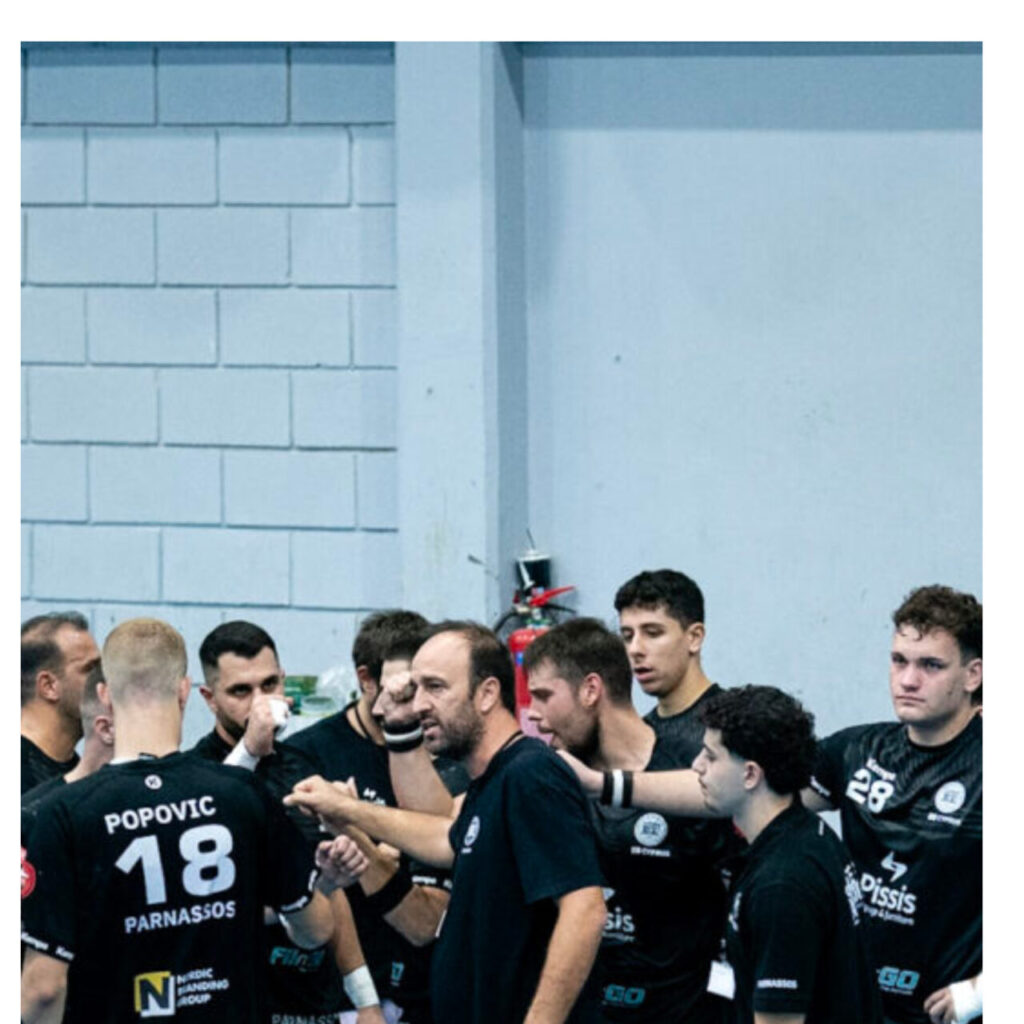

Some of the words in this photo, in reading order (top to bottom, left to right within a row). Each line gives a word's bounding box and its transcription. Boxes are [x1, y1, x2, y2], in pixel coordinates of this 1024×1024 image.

[845, 768, 895, 814] 28
[104, 796, 216, 835] POPOVIC
[115, 824, 236, 905] 18
[124, 900, 236, 933] PARNASSOS
